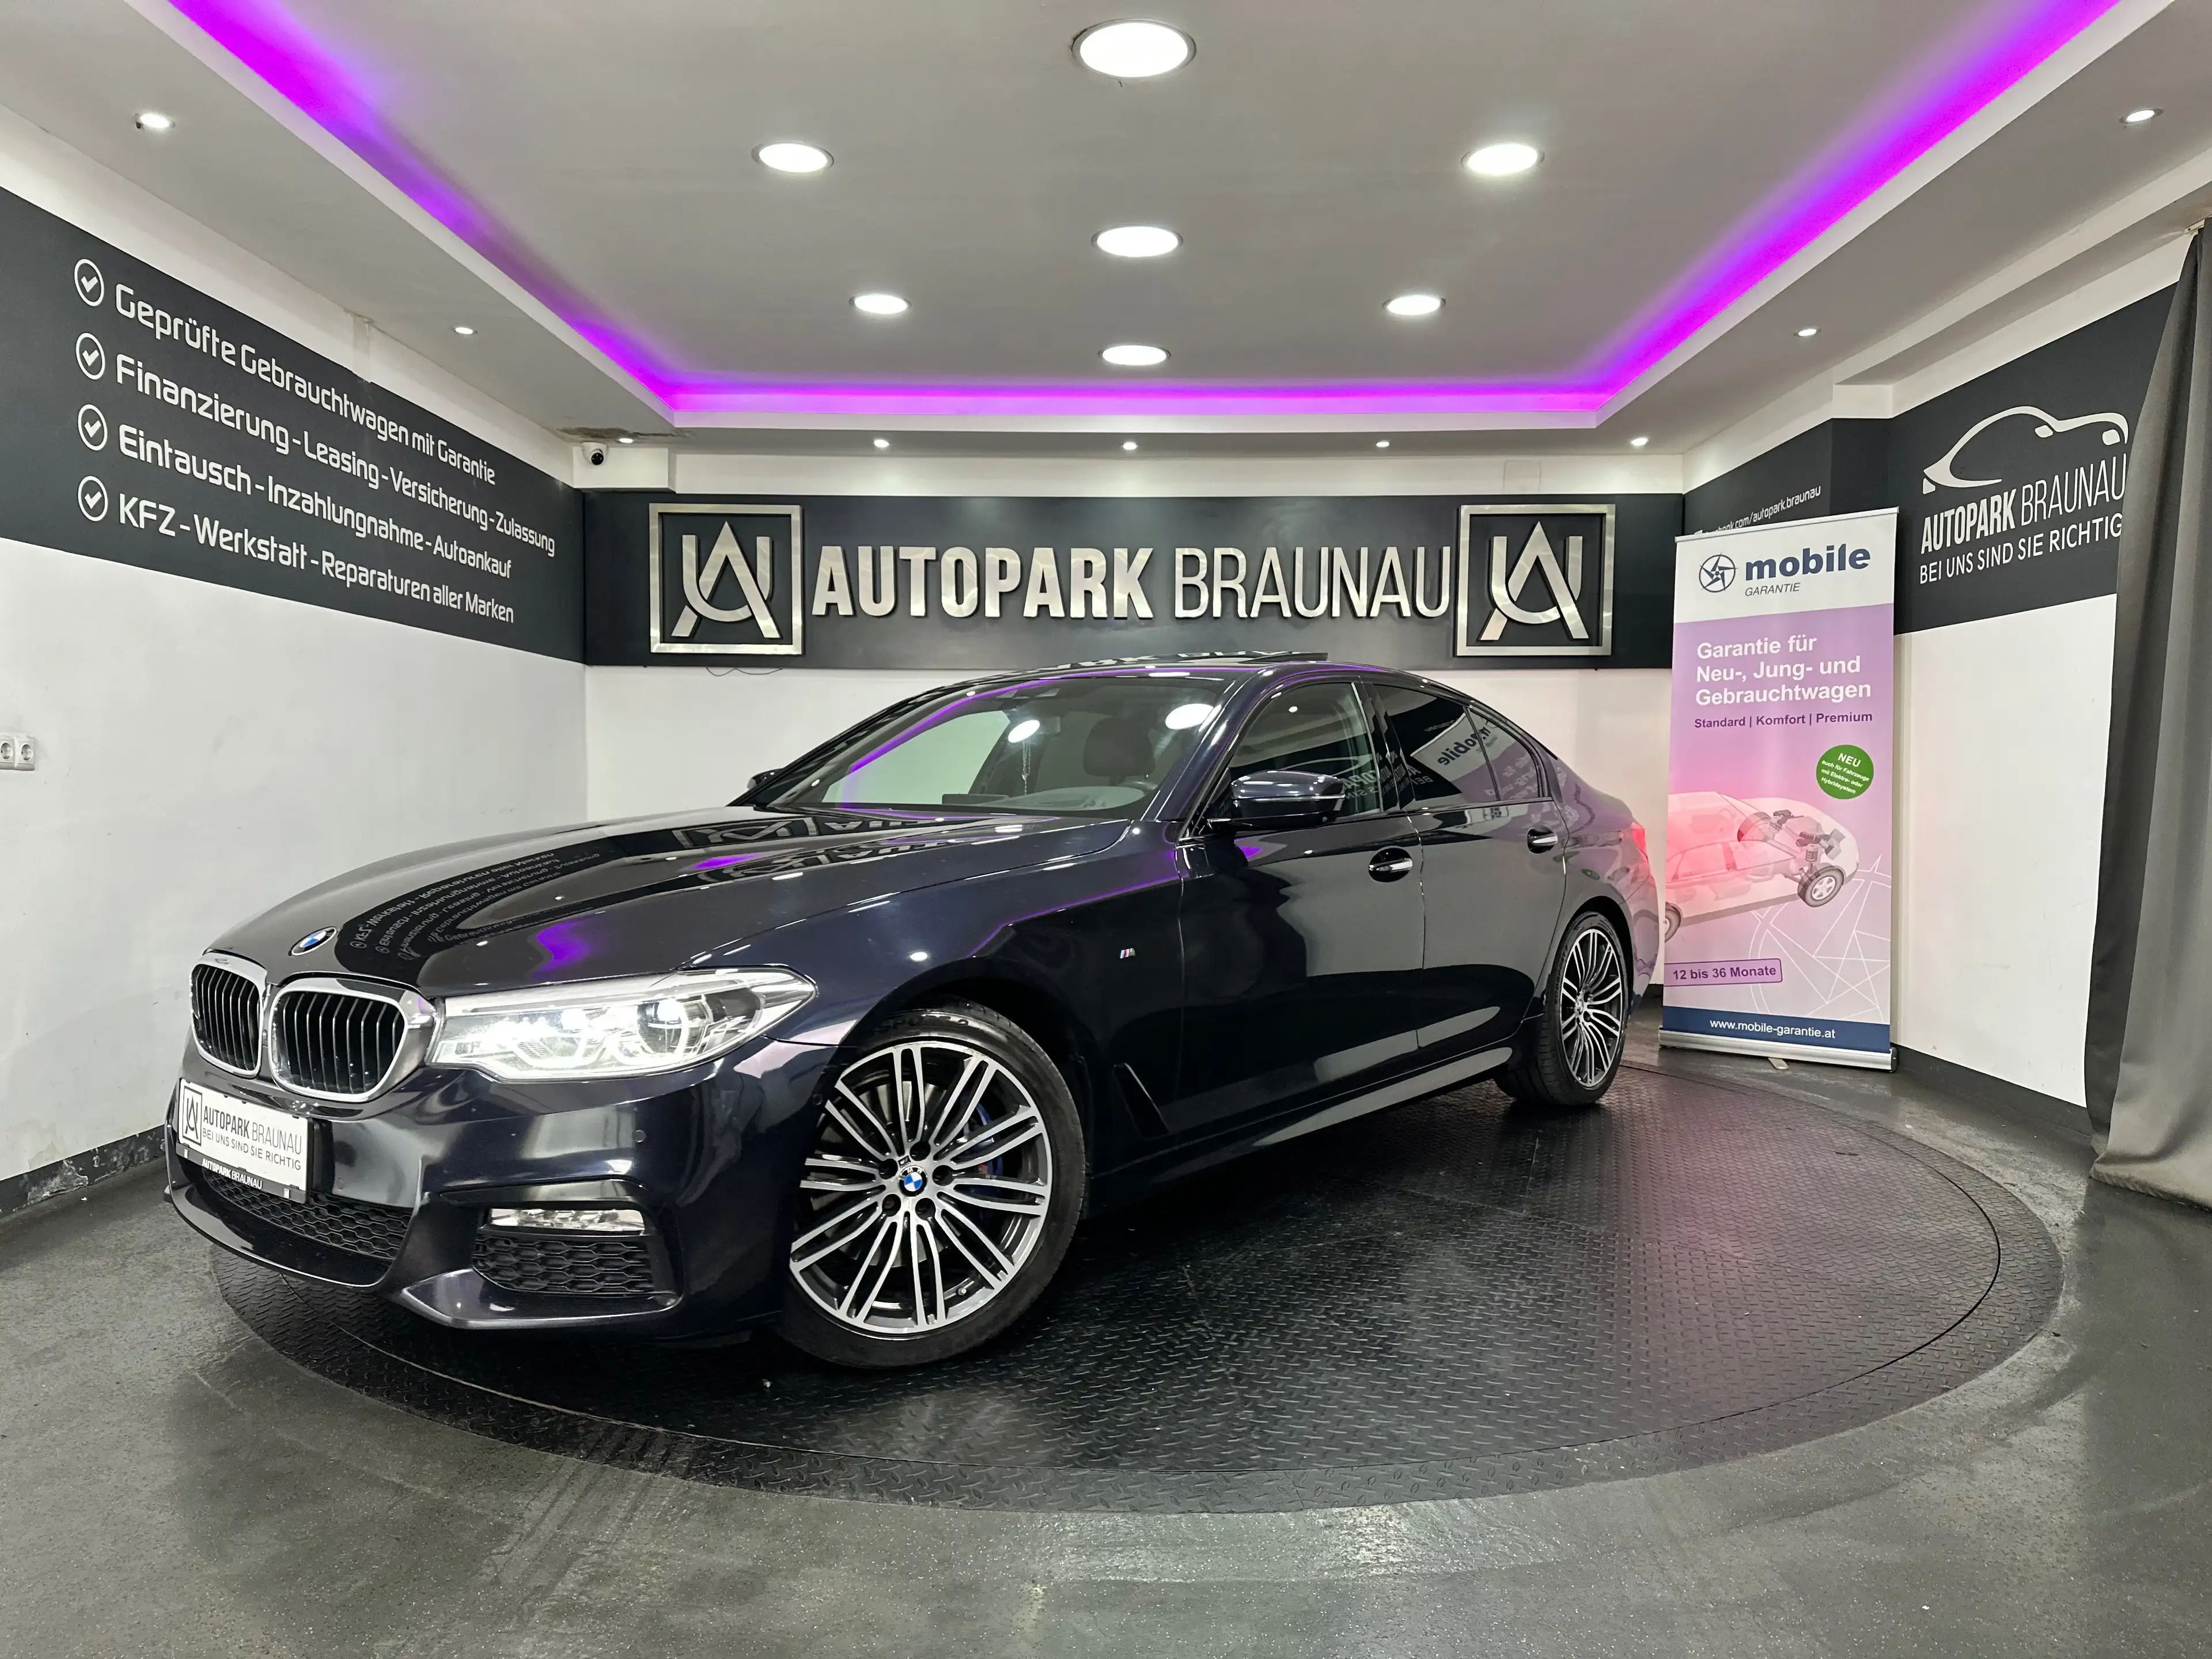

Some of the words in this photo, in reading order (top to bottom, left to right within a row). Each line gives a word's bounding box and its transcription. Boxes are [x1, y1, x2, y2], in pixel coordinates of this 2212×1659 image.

[116, 283, 236, 366] Geprüfte
[241, 344, 408, 445] Gebrauchtwagen
[412, 433, 434, 457] mit
[438, 440, 495, 485] Garantie
[116, 354, 289, 455] Finanzierung
[304, 431, 378, 490] Leasing
[389, 467, 488, 531] Versicherung
[495, 511, 555, 558] Zulassung
[119, 424, 251, 495] Eintausch
[268, 476, 423, 551] Inzahlungnahme
[433, 535, 512, 579] Autoankauf
[1921, 488, 2017, 554] AUTOPARK
[2021, 453, 2127, 527] BRAUNAU
[119, 493, 176, 536] KFZ
[194, 514, 308, 570] Werkstatt
[321, 550, 430, 603] Reparaturen
[433, 585, 463, 610] aller
[465, 592, 514, 623] Marken
[1745, 543, 1870, 581] mobile
[1920, 560, 1942, 584] BEI
[1946, 551, 1974, 578] UNS
[1977, 542, 2013, 570] SIND
[2017, 532, 2044, 560] SIE
[2049, 512, 2123, 552] RICHTIG
[812, 546, 1153, 618] AUTOPARK
[1175, 546, 1450, 618] BRAUNAU
[1745, 582, 1801, 597] GARANTIE
[1697, 638, 1781, 660] Garantie
[1788, 634, 1817, 653] für
[1696, 665, 1747, 683] Neu-,
[1753, 662, 1813, 681] Jung-
[1820, 656, 1861, 674] und
[1696, 683, 1872, 706] Gebrauchtwagen
[1695, 717, 1746, 729] Standard
[1756, 714, 1806, 726] Komfort
[1816, 712, 1873, 724] Premium
[1838, 753, 1861, 767] NEU
[1821, 777, 1856, 794] Hybridsystem
[1673, 969, 1687, 980] 12
[1690, 968, 1709, 980] bis
[1712, 968, 1727, 979] 36
[1730, 966, 1777, 978] Monate
[1710, 1019, 1836, 1039] www.mobile-garantie.at
[203, 1105, 250, 1139] AUTOPARK
[252, 1122, 302, 1156] BRAUNAU
[202, 1127, 214, 1141] BEI
[215, 1133, 230, 1147] UNS
[231, 1138, 249, 1154] SIND
[251, 1145, 263, 1158] SIE
[266, 1150, 301, 1171] RICHTIG
[202, 1158, 231, 1178] AUTOPARK
[232, 1171, 263, 1190] BRAUNAU
